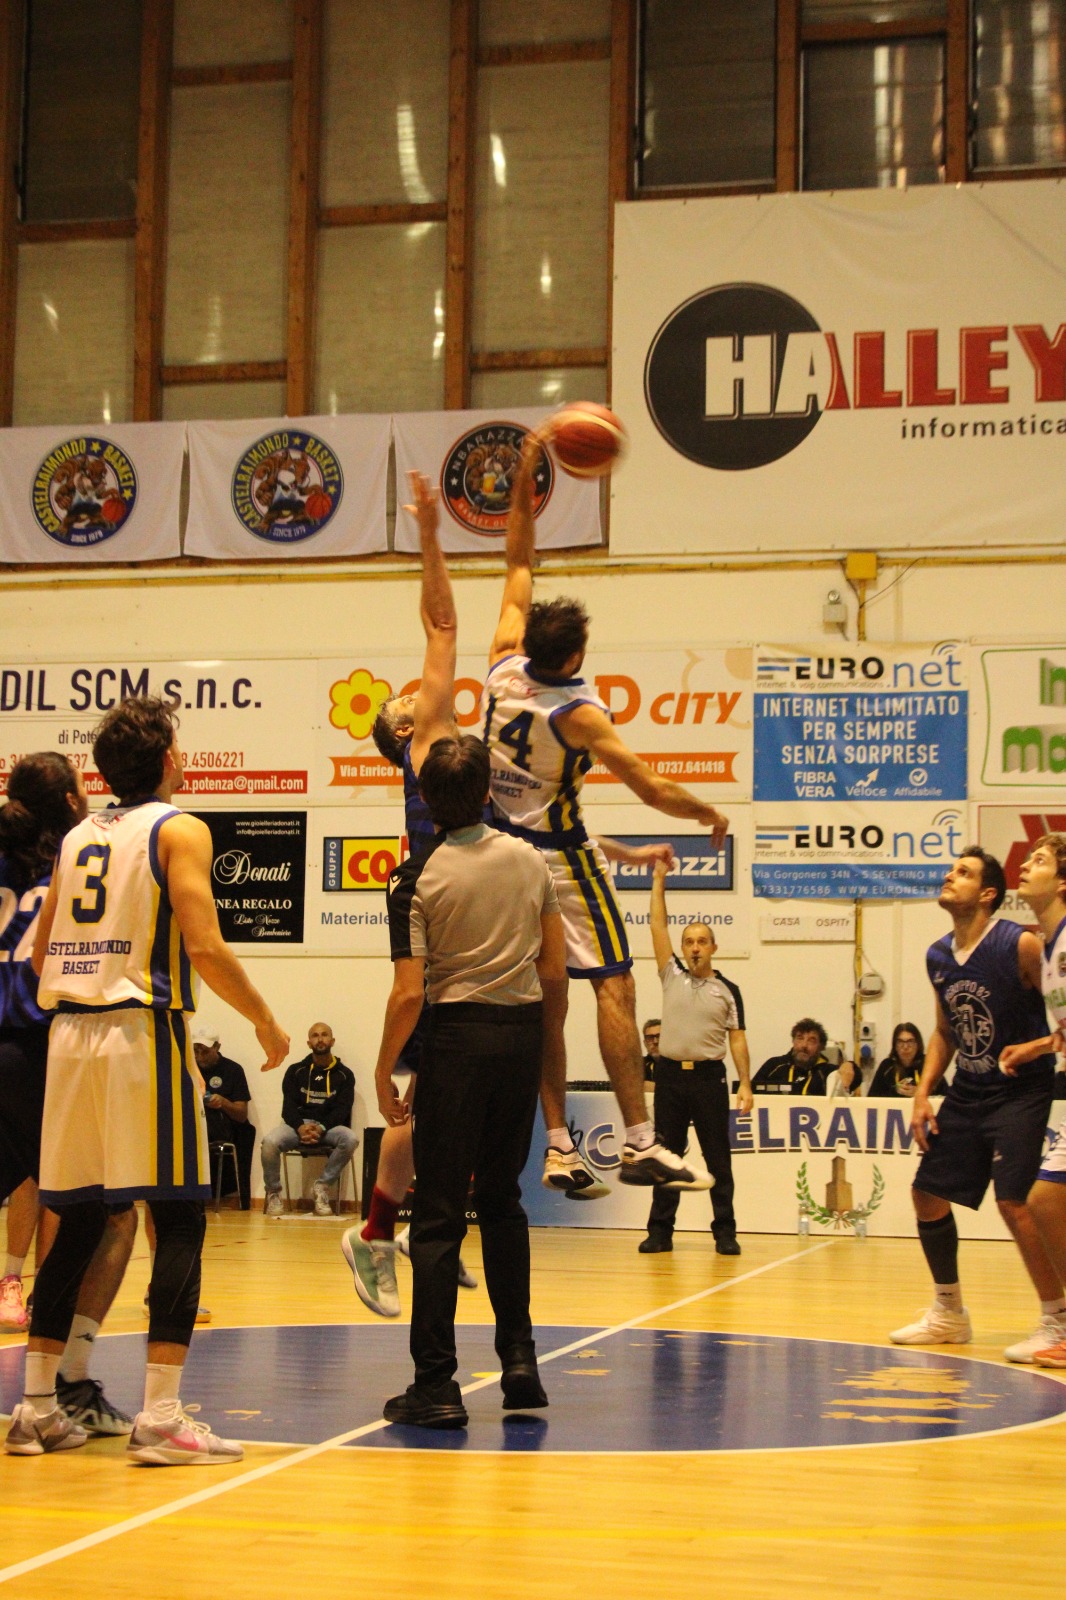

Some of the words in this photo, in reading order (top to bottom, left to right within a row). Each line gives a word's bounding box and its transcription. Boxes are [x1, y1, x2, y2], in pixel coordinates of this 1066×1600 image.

[704, 323, 1066, 422] HALLEY
[901, 414, 1066, 440] informatica
[103, 445, 135, 487] BASKET
[305, 438, 339, 481] BASKET
[70, 669, 150, 711] SCM
[163, 678, 262, 709] s.n.c.
[650, 692, 743, 725] CITY
[763, 697, 849, 718] INTERNET
[856, 695, 960, 717] ILLIMITATO
[58, 730, 69, 744] di
[73, 730, 98, 744] Pote
[803, 721, 836, 740] PER
[843, 720, 917, 740] SEMPRE
[499, 710, 534, 772] 4
[781, 745, 838, 765] SENZA
[844, 744, 939, 764] SORPRESE
[340, 765, 357, 777] Via
[360, 765, 394, 777] Enrico
[657, 761, 726, 773] 0737.641418
[794, 771, 836, 783] FIBRA
[796, 786, 835, 798] VERA
[845, 786, 887, 797] Veloce
[894, 786, 942, 797] Affidabile
[213, 850, 291, 885] Donati
[328, 841, 337, 887] GRUPPO
[72, 844, 111, 923] 3
[754, 870, 770, 878] Via
[774, 870, 826, 880] Gorgonero
[242, 899, 292, 909] REGALO
[321, 912, 389, 925] Materiale
[625, 911, 733, 925] Autmazione
[773, 917, 800, 926] CASA
[48, 940, 131, 956] ASTELRAIMONDO
[62, 960, 100, 975] BASKET
